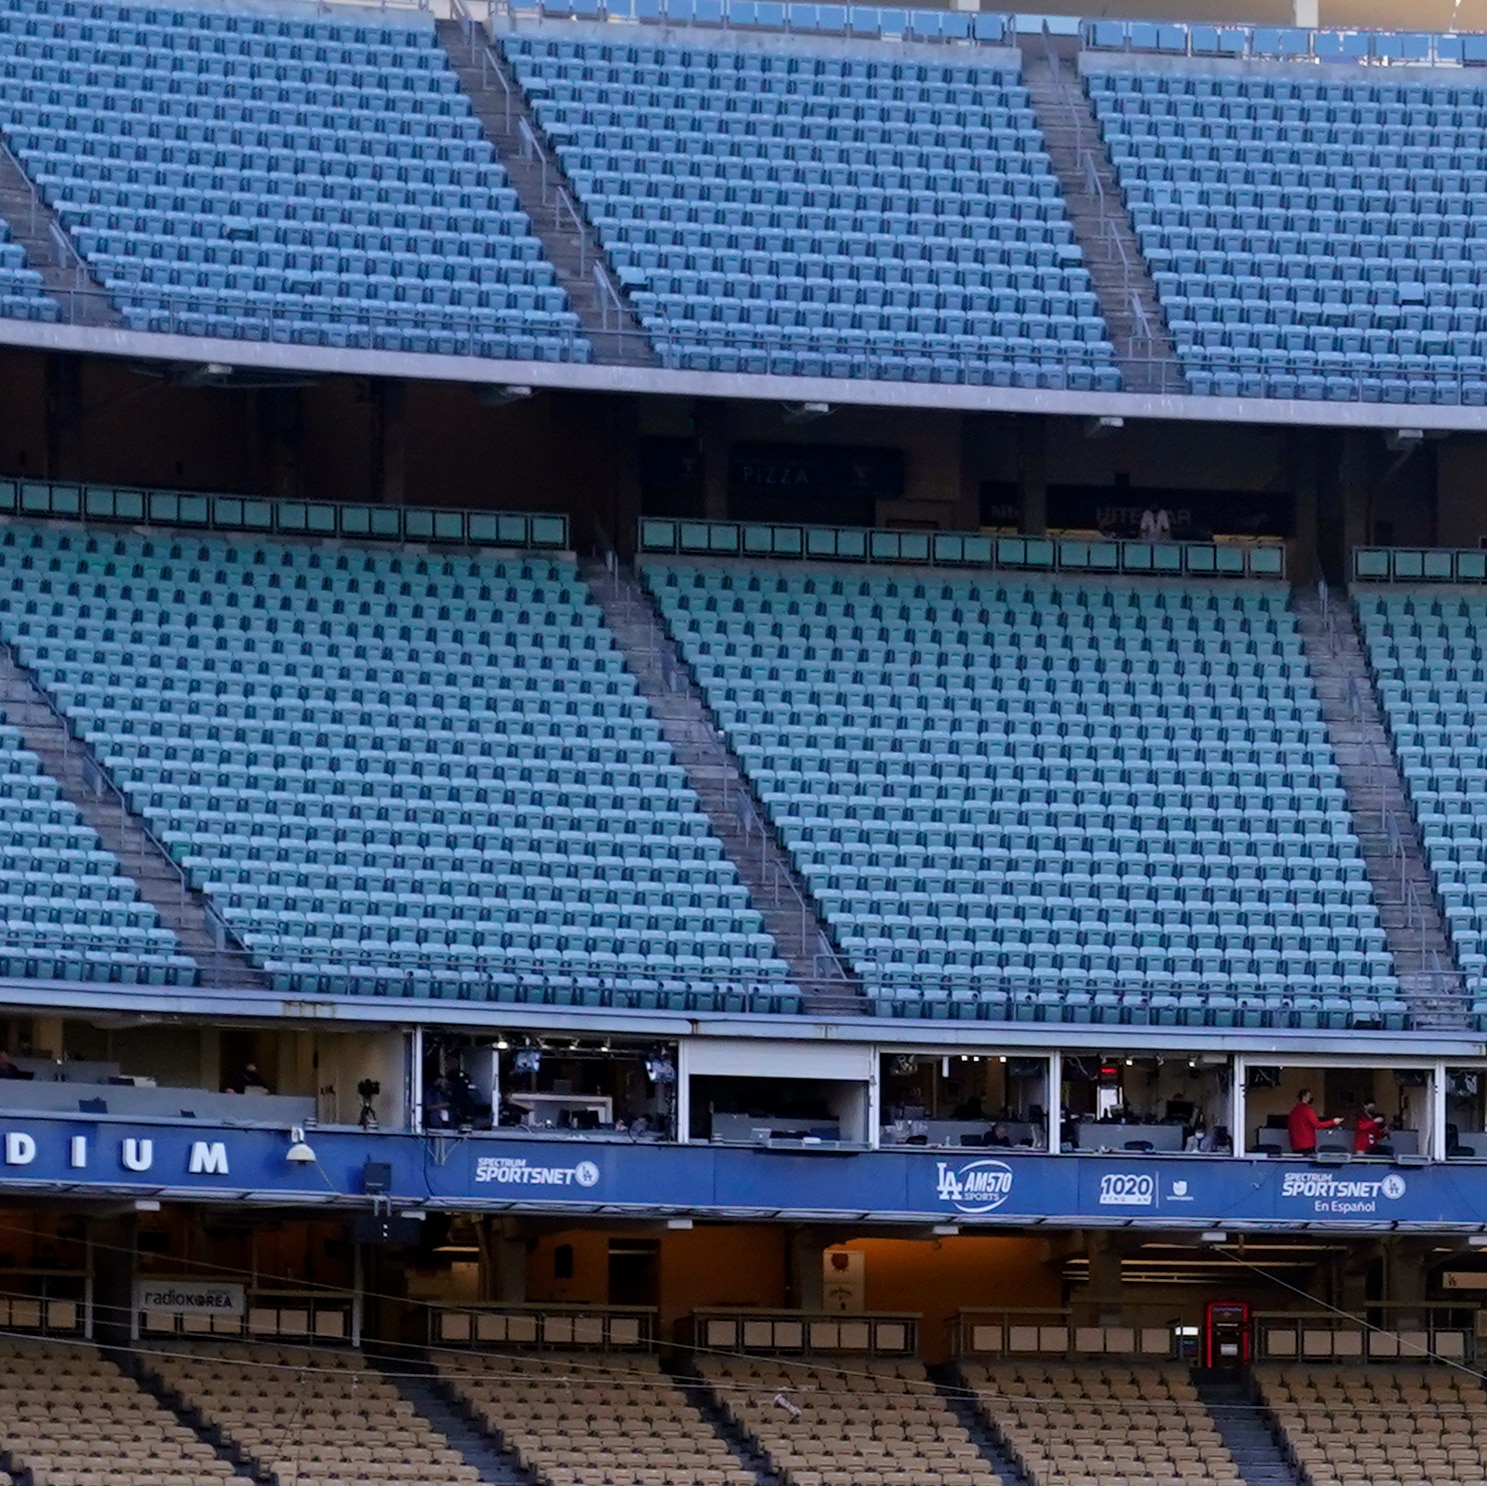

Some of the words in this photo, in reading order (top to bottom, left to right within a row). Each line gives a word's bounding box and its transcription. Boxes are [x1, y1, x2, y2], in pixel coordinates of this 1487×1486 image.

[478, 1157, 527, 1168] SPECTRUM
[475, 1167, 577, 1185] SPORTSNET
[937, 1162, 963, 1200] LA
[962, 1172, 1013, 1193] AM570
[1284, 1172, 1333, 1183] SPECTRUM
[1100, 1175, 1153, 1197] 1020
[1282, 1181, 1382, 1198] SPORTSNET
[963, 1192, 1000, 1201] SPORTS
[1315, 1201, 1330, 1212] En
[1331, 1201, 1375, 1215] Español
